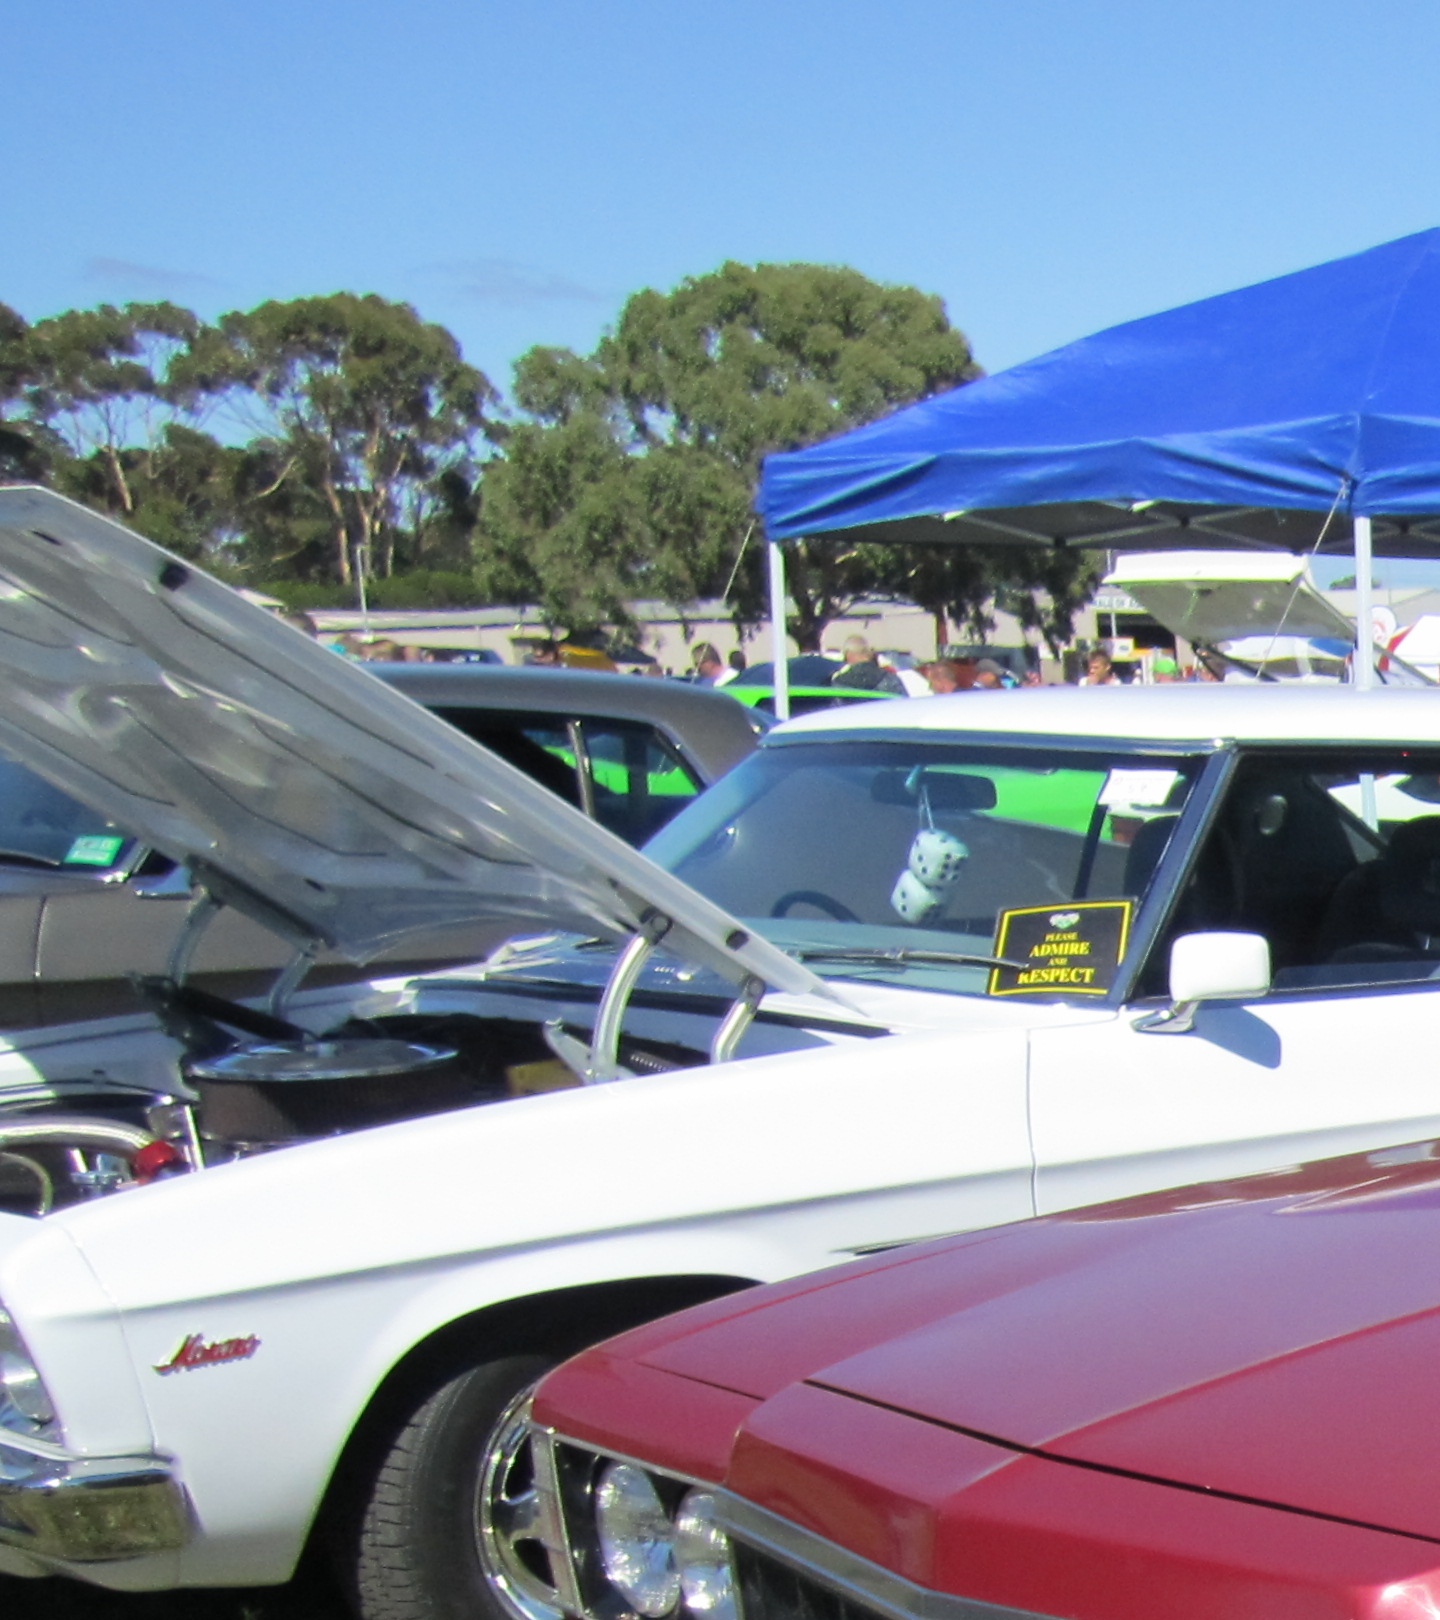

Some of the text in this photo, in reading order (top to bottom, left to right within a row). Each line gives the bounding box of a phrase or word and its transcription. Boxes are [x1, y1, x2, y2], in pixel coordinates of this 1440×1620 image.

[1045, 932, 1079, 942] PLEASE
[1029, 942, 1091, 957] ADMIRE
[1048, 957, 1068, 966] AND
[1017, 967, 1095, 984] RESPECT
